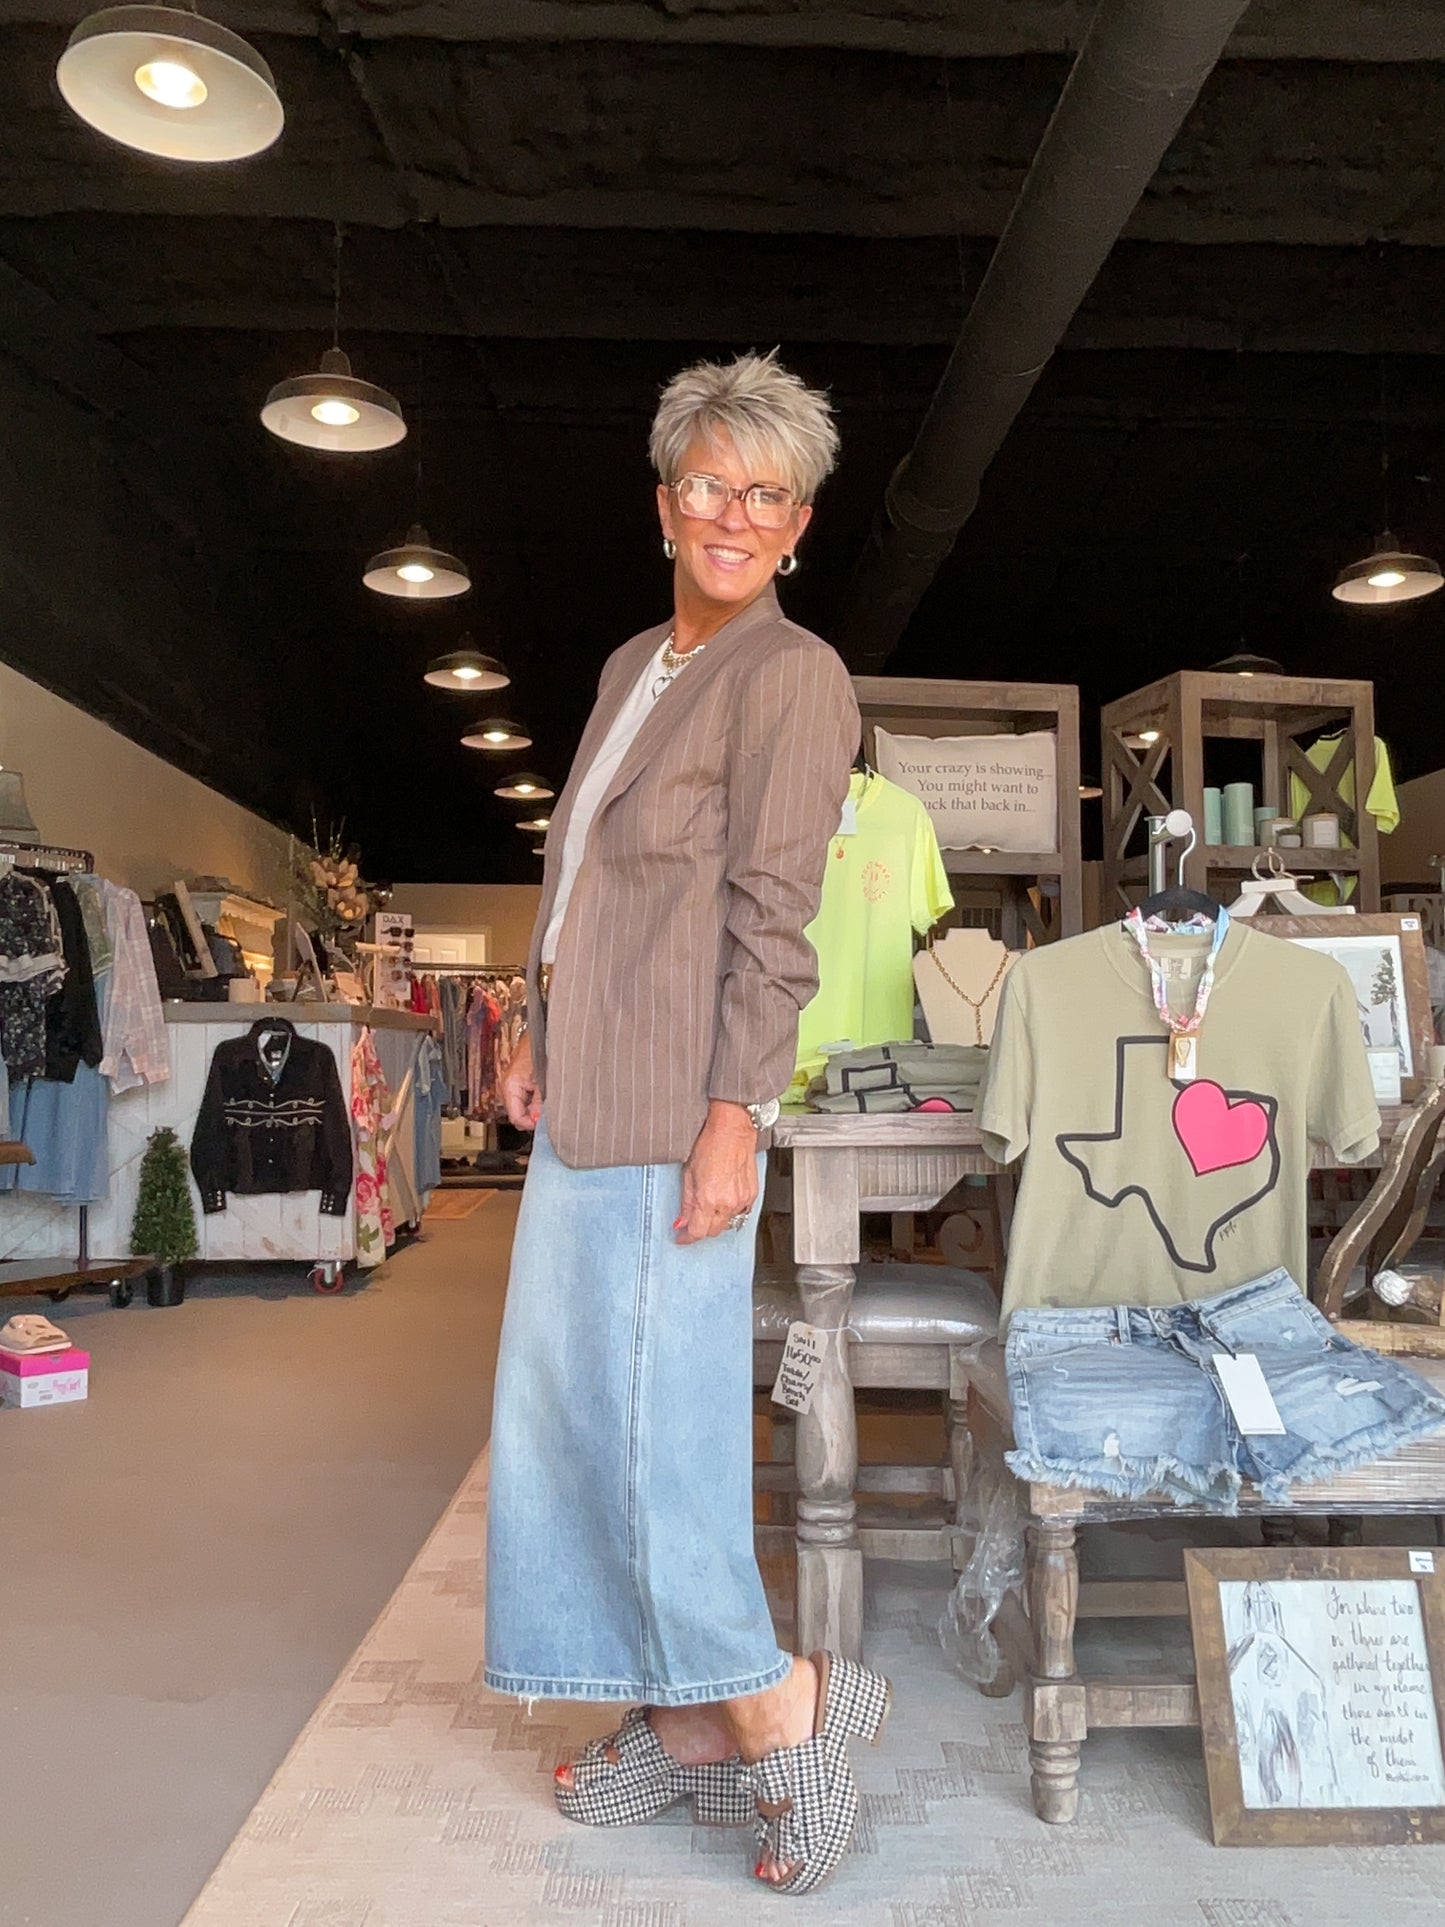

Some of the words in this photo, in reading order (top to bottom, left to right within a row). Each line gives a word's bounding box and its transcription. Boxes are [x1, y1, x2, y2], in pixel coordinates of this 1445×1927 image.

[898, 761, 932, 774] Your
[934, 764, 972, 778] crazy
[976, 762, 987, 774] is
[917, 779, 943, 792] You
[948, 779, 987, 795] might
[991, 782, 1023, 794] want
[1026, 784, 1039, 795] to
[923, 797, 947, 810] uck
[951, 797, 976, 810] that
[981, 797, 1010, 812] back
[1326, 1586, 1351, 1620] For
[1390, 1595, 1414, 1616] two
[1390, 1634, 1409, 1646] are
[1332, 1651, 1380, 1684] gathered
[1353, 1682, 1370, 1693] in
[1348, 1726, 1371, 1746] the
[1367, 1751, 1380, 1778] of
[1385, 1748, 1416, 1767] them
